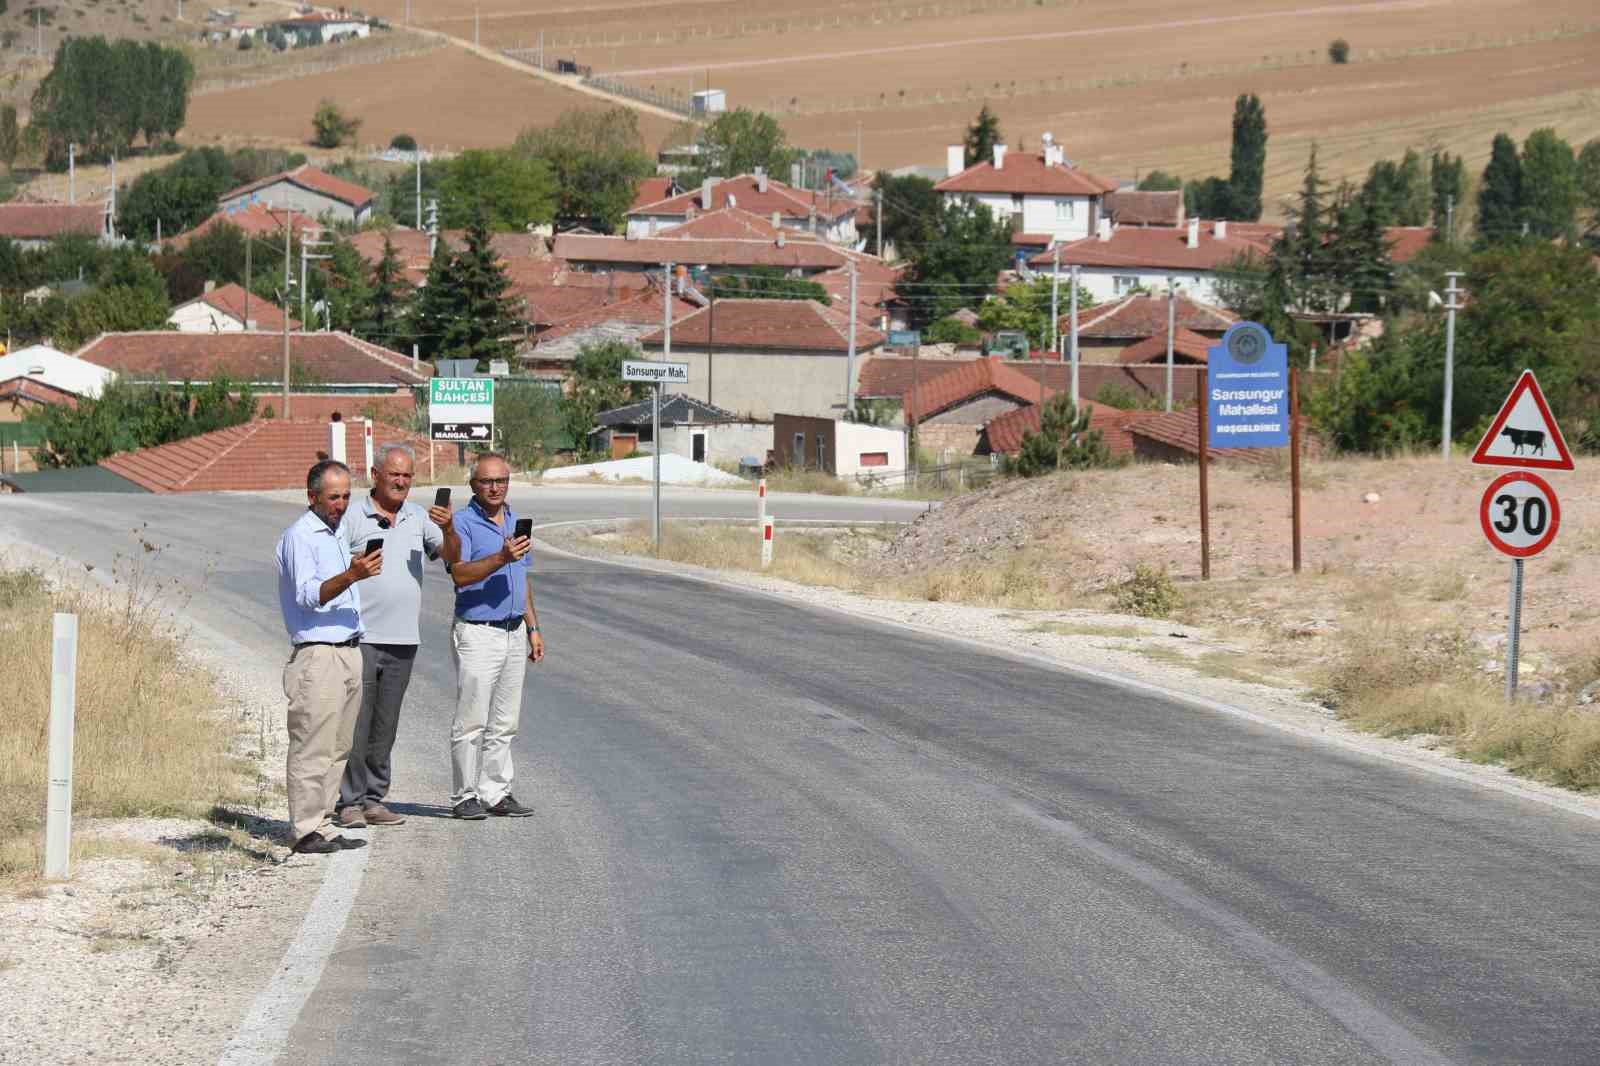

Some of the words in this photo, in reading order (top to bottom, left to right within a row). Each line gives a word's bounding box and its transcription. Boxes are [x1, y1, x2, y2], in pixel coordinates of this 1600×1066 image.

[668, 367, 686, 379] Mah.
[438, 380, 485, 392] SULTAN
[434, 388, 490, 404] BAHÇESİ
[1212, 388, 1285, 403] Sarısungur
[1219, 403, 1278, 416] Mahallesi
[1494, 494, 1547, 536] 30
